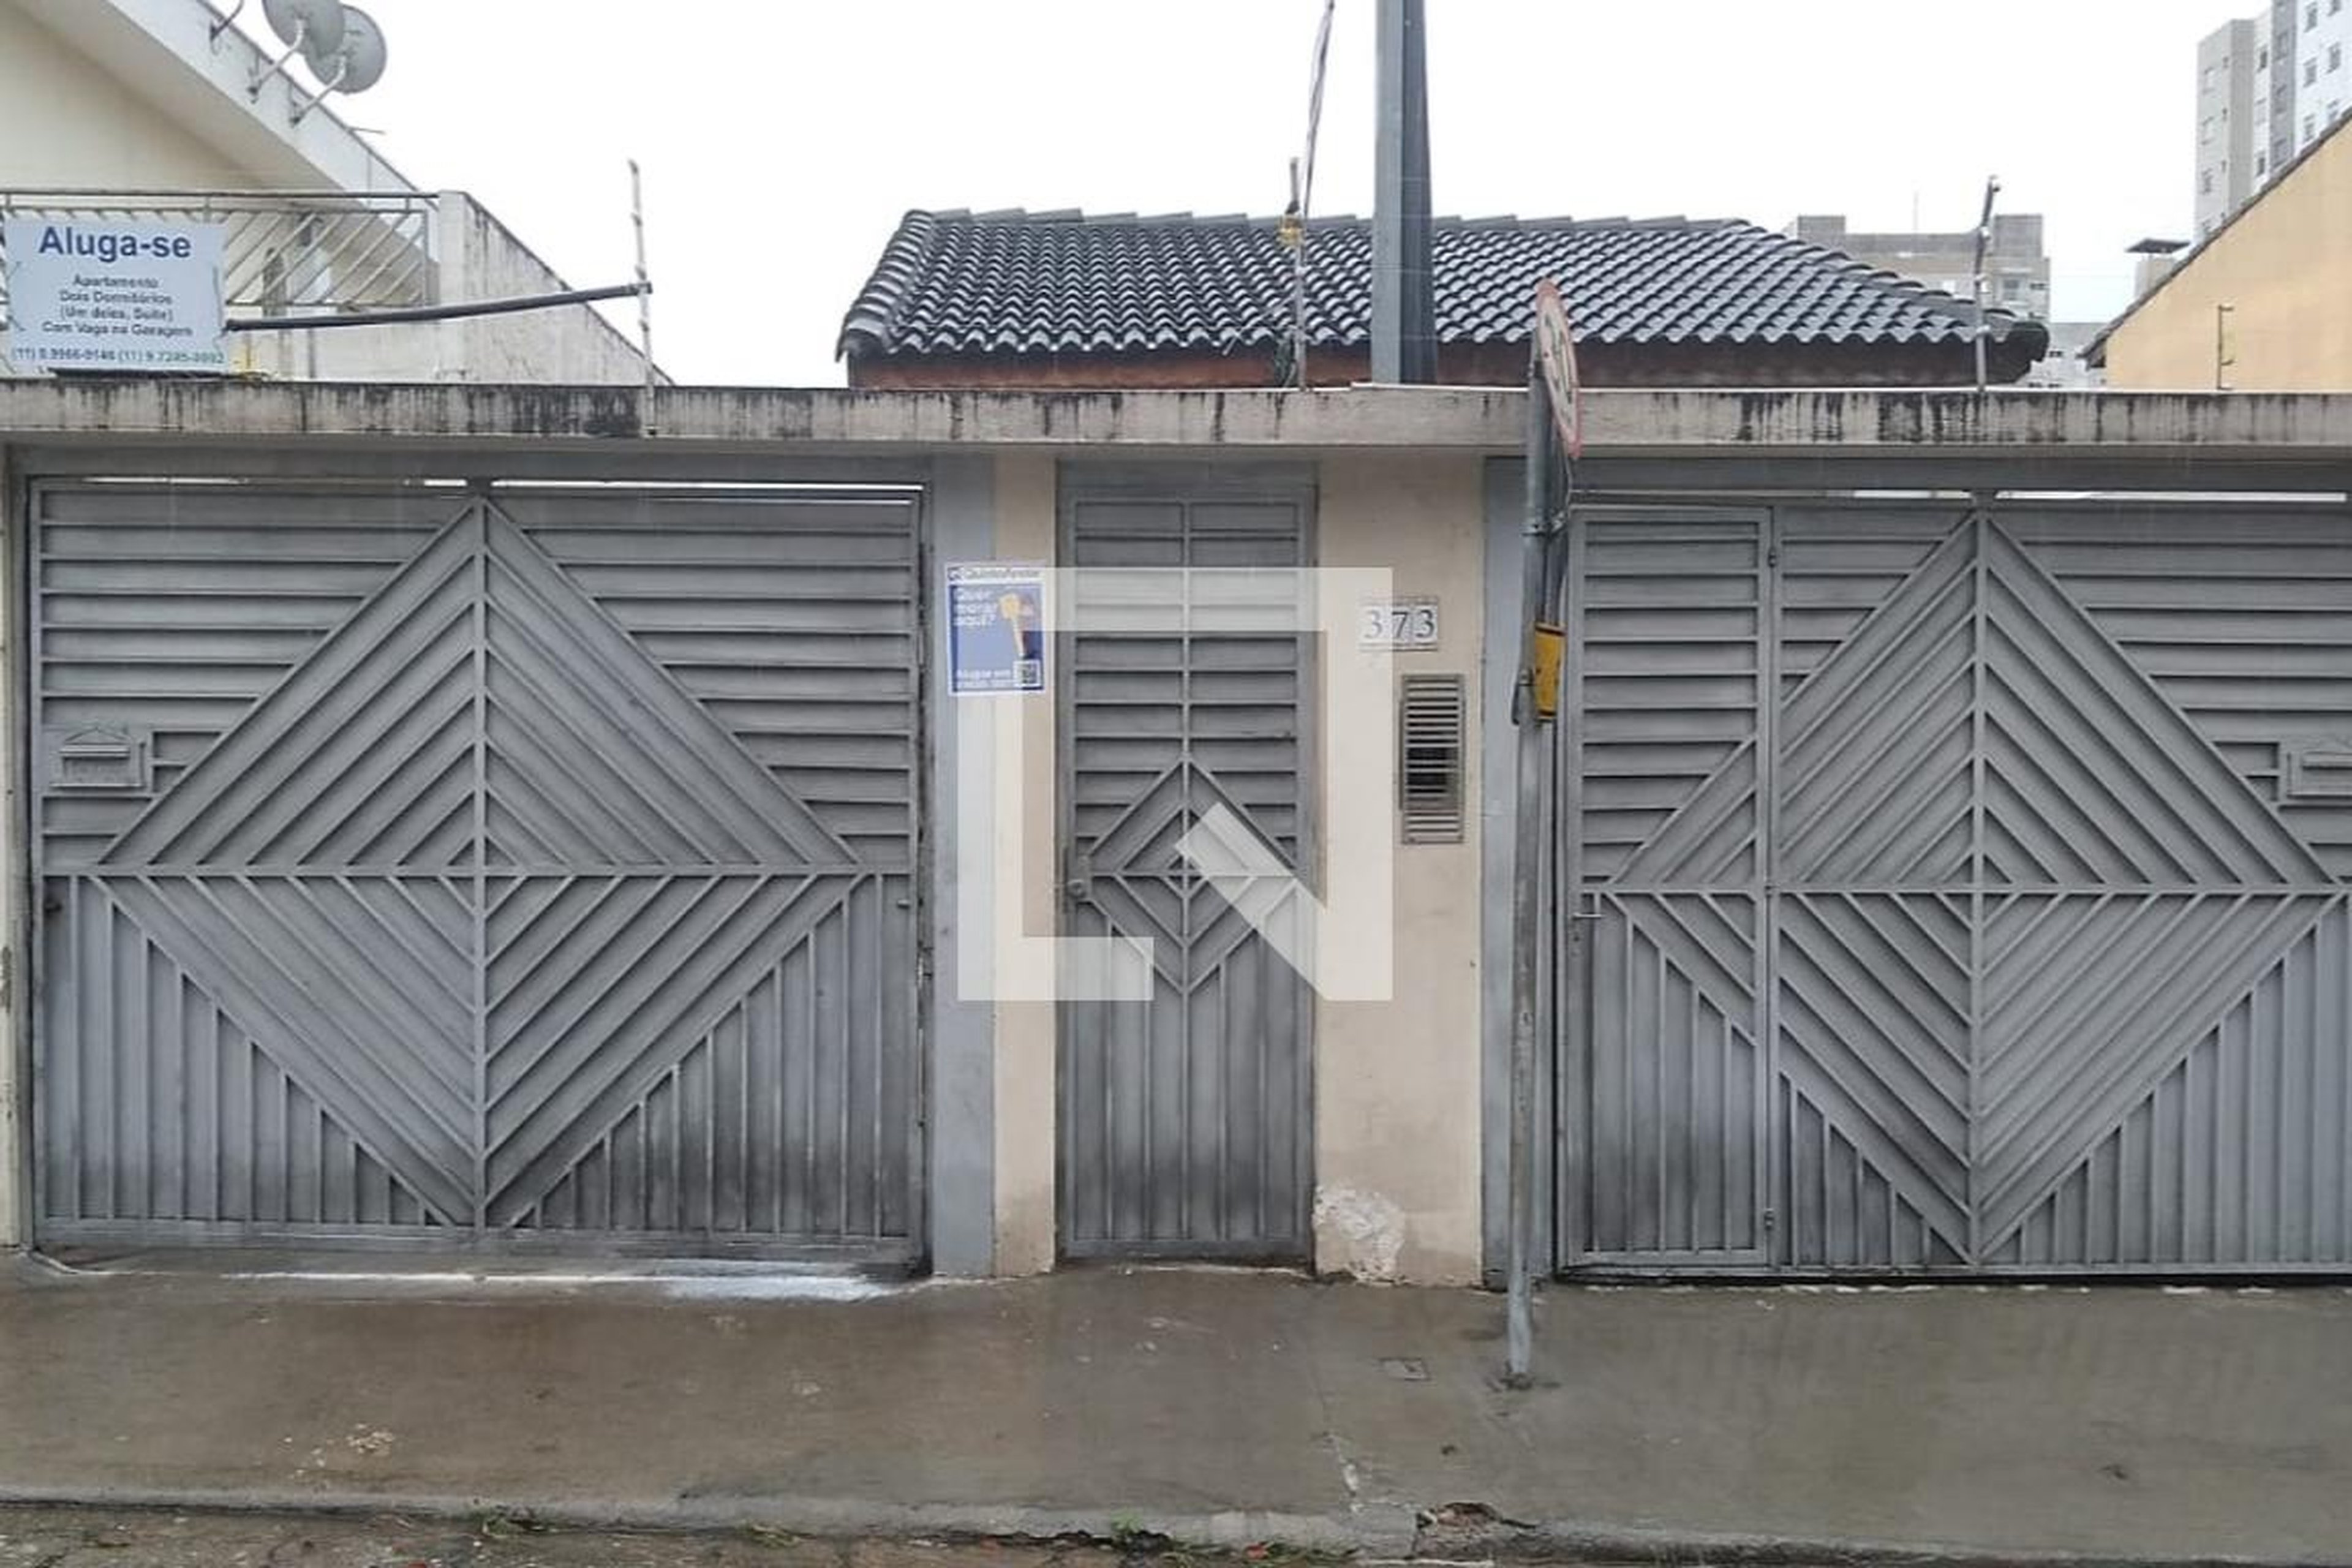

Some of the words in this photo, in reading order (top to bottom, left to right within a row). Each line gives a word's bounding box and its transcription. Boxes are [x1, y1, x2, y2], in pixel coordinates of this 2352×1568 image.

[39, 227, 191, 263] Aluga-se
[72, 274, 159, 288] Apartamento
[60, 290, 90, 302] Dois
[42, 321, 72, 333] Com
[131, 324, 192, 337] Garagem
[1364, 609, 1434, 638] 373
